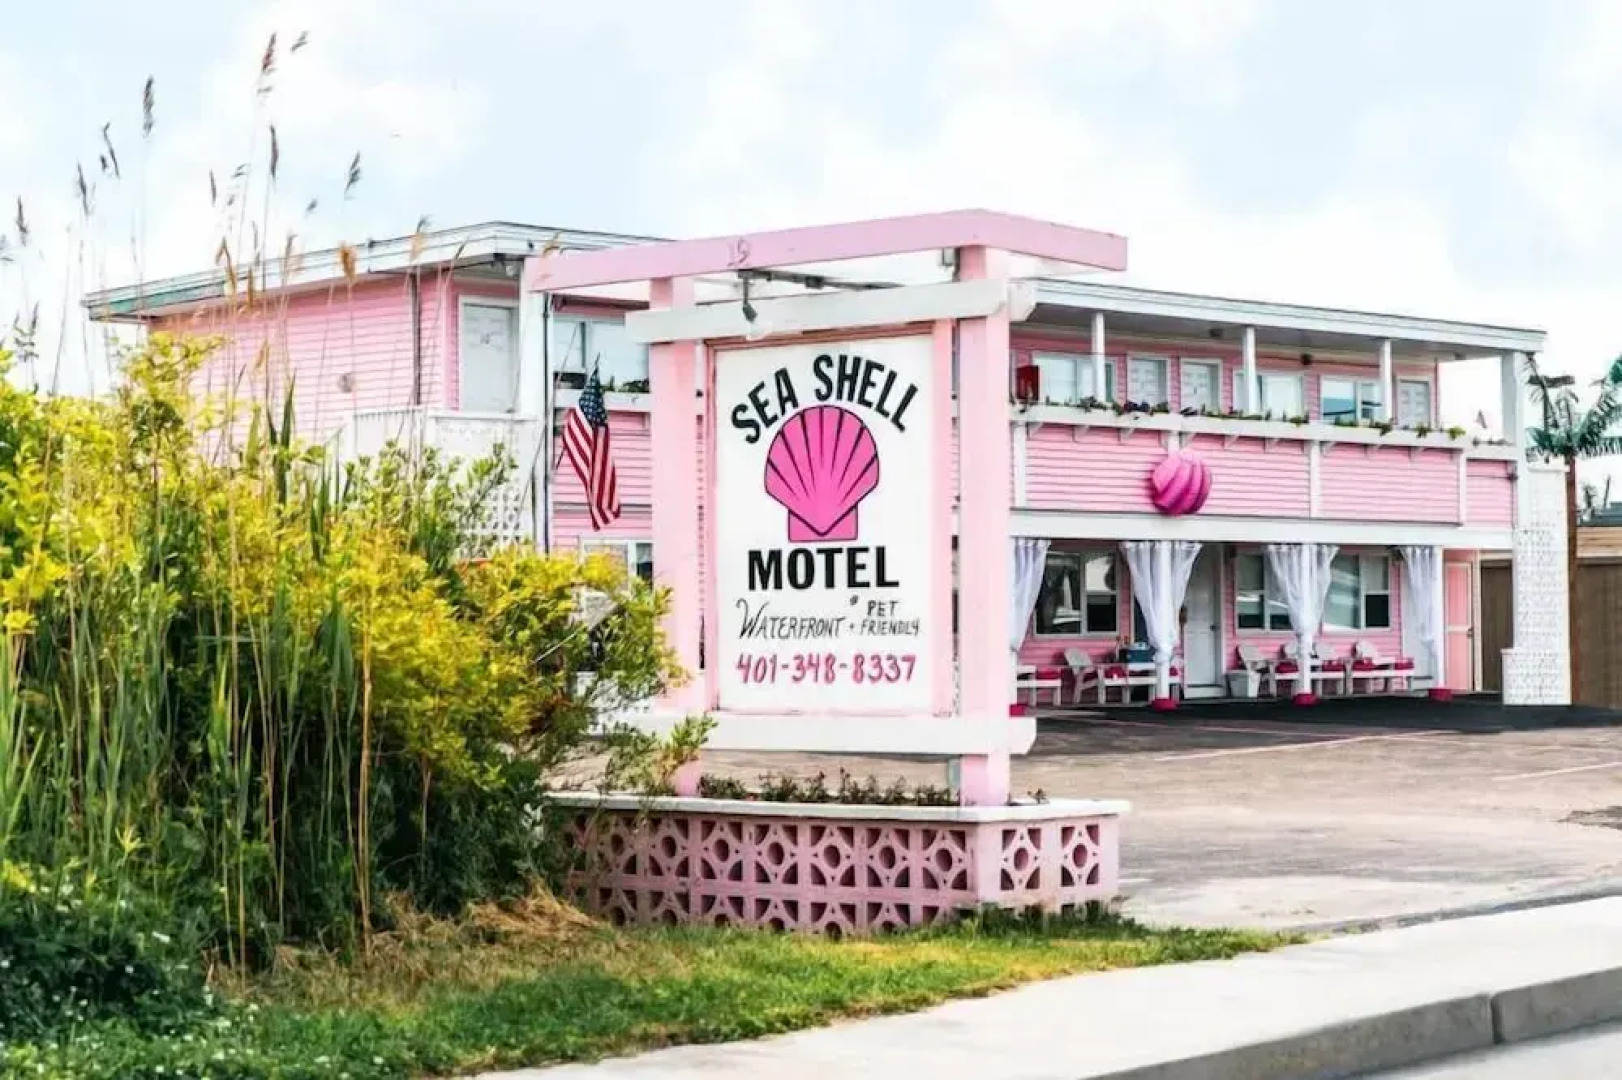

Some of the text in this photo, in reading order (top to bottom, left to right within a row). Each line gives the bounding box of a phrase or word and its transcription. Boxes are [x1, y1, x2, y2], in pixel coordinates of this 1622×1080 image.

[731, 354, 919, 444] SEA SHELL
[747, 546, 900, 591] MOTEL
[736, 598, 921, 640] WATERFRONT FRIENDLY
[867, 600, 899, 617] PET
[735, 652, 917, 684] 401-348-8337
